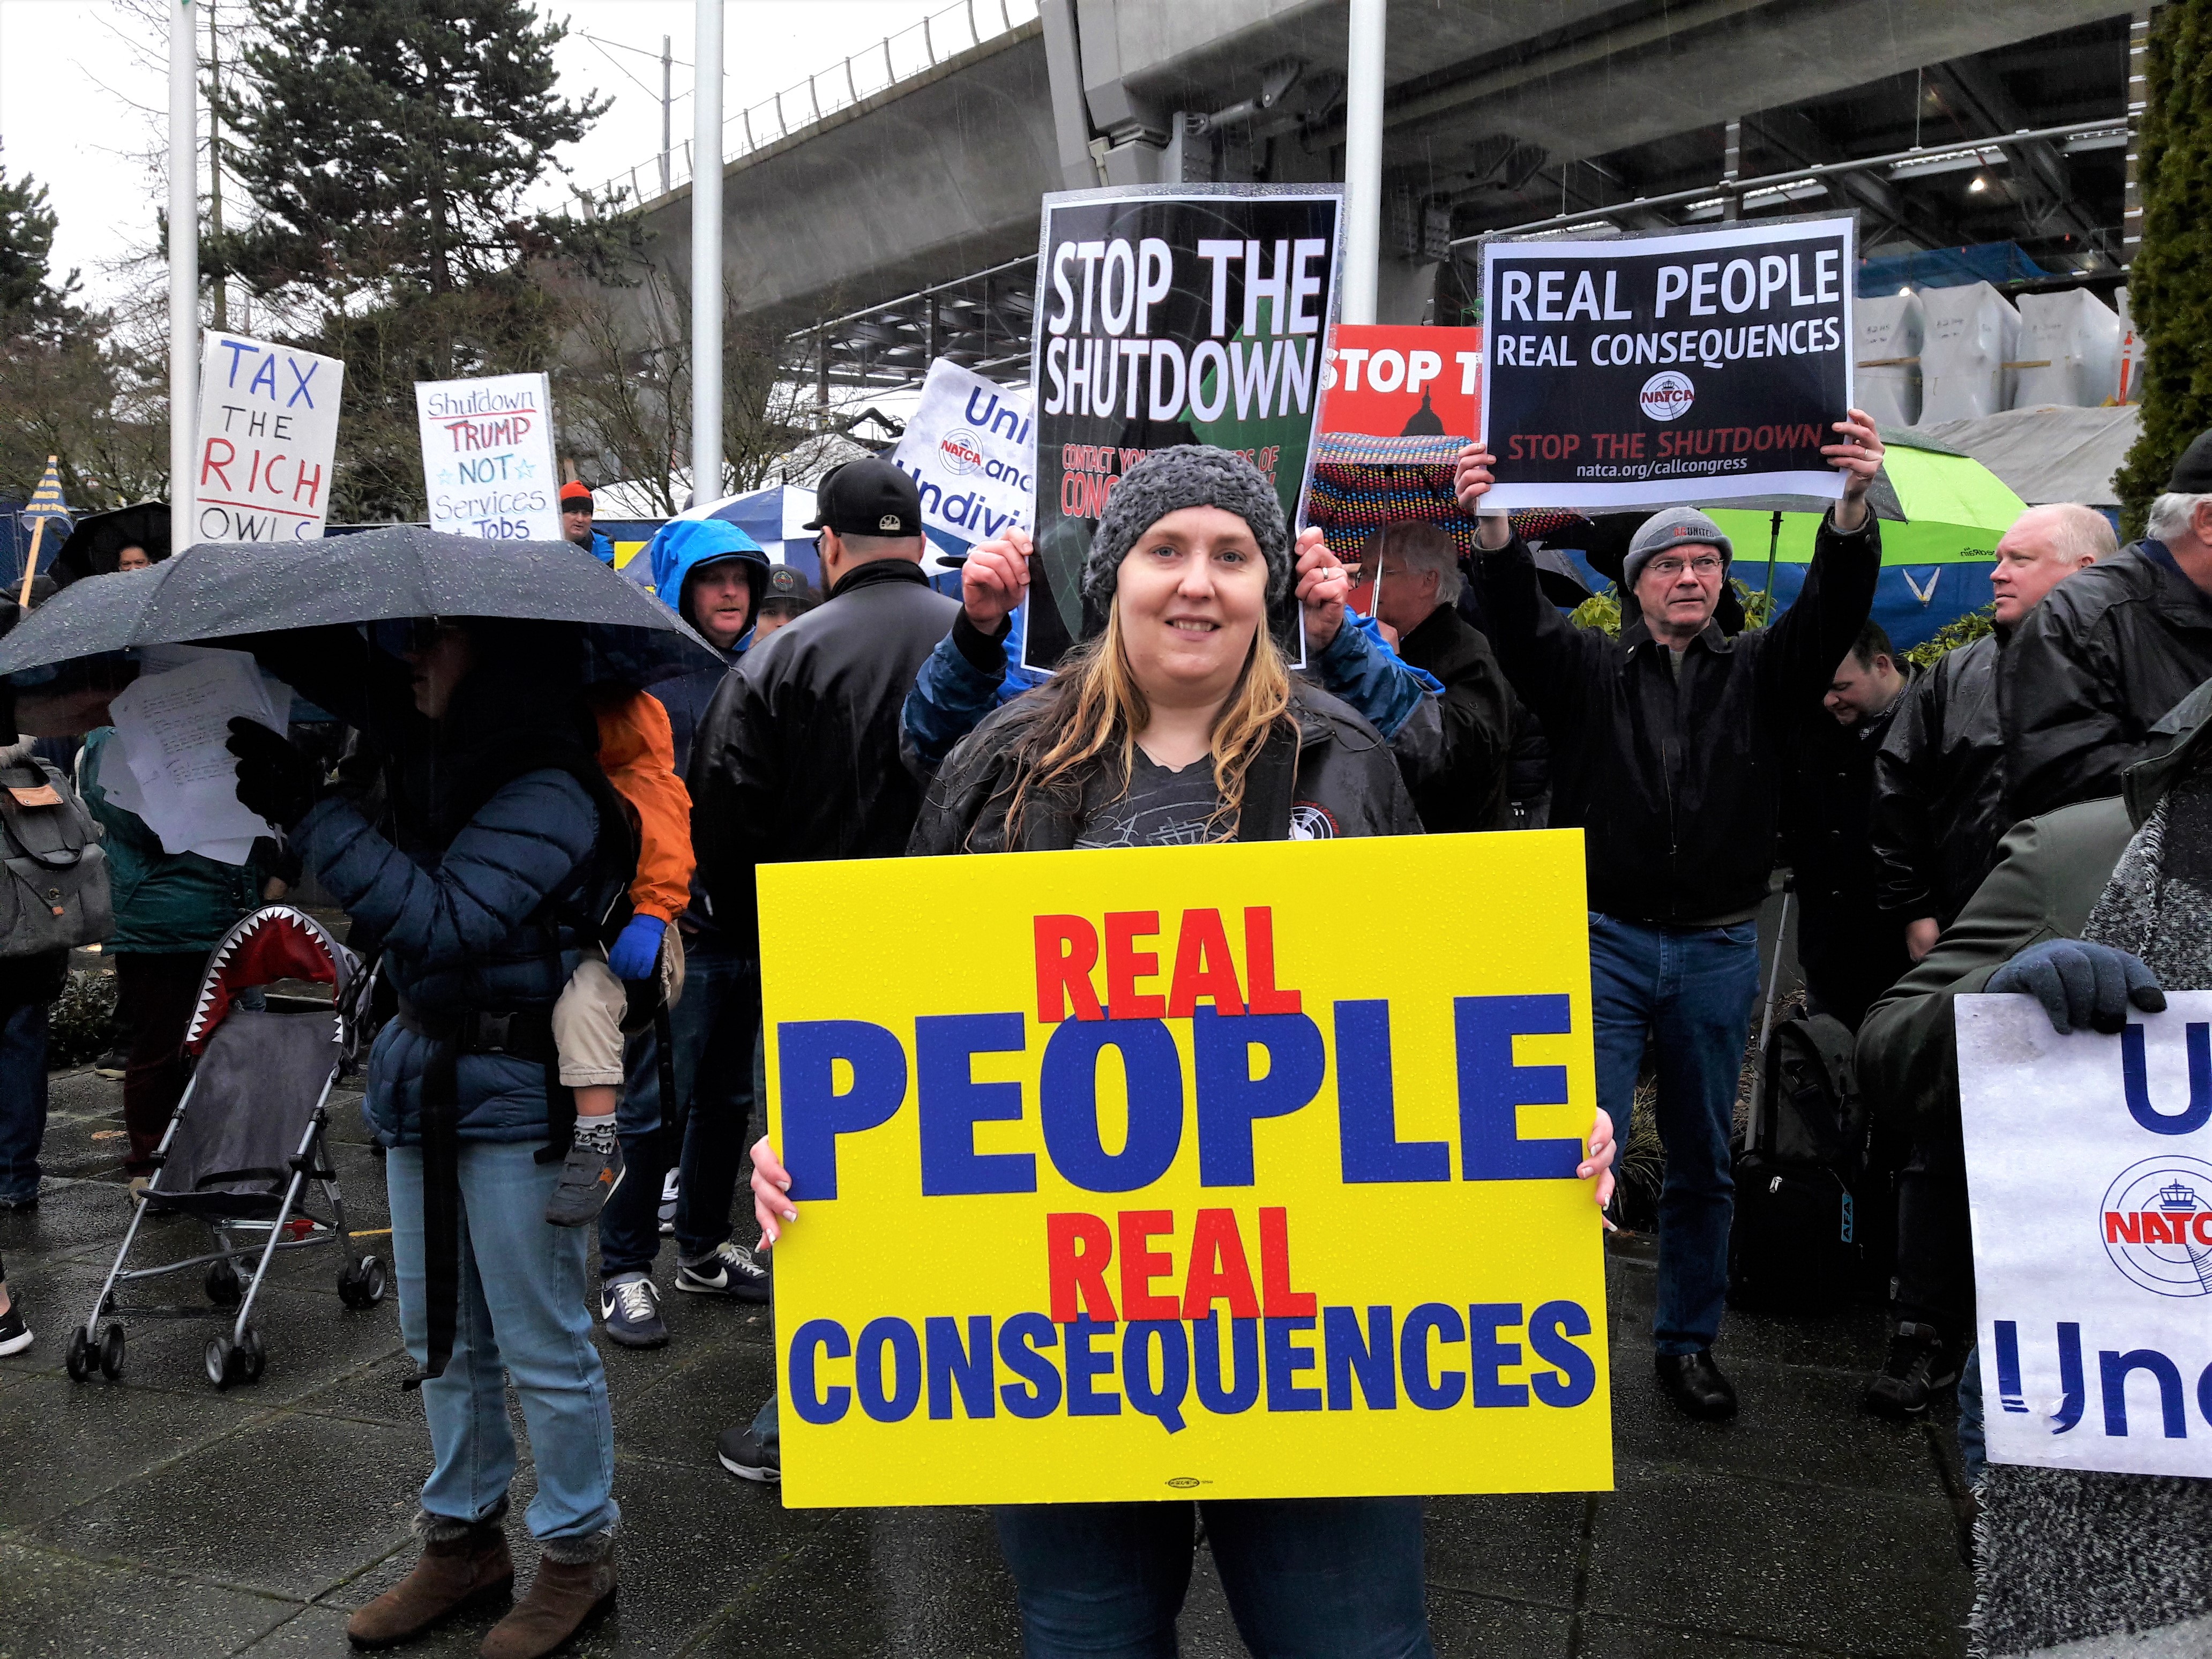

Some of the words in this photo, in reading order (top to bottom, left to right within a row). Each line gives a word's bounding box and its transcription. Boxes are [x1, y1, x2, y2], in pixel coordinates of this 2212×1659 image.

[1048, 237, 1174, 336] STOP
[1197, 238, 1326, 338] THE
[1500, 270, 1633, 322] REAL
[1654, 249, 1840, 320] PEOPLE
[1497, 334, 1578, 367] REAL
[1590, 316, 1840, 369] CONSEQUENCES
[220, 339, 319, 410] TAX
[1044, 337, 1317, 423] SHUTDOWN
[427, 387, 535, 416] Shutdown
[1641, 389, 1695, 403] NATCA
[221, 405, 293, 440] THE
[444, 416, 532, 453] TRUMP
[940, 439, 981, 466] NATCA
[1062, 443, 1116, 474] CONTACT
[1259, 445, 1280, 473] OF
[1508, 434, 1580, 460] STOP
[1591, 432, 1646, 459] THE
[1656, 423, 1822, 458] SHUTDOWN
[200, 437, 320, 508] RICH
[458, 453, 514, 485] NOT
[1576, 457, 1747, 480] natca.org/callcongress
[435, 490, 547, 520] Services
[1032, 905, 1302, 1023] REAL
[776, 992, 1583, 1201] PEOPLE
[1046, 1206, 1318, 1323] REAL
[788, 1299, 1596, 1434] CONSEQUENCES
